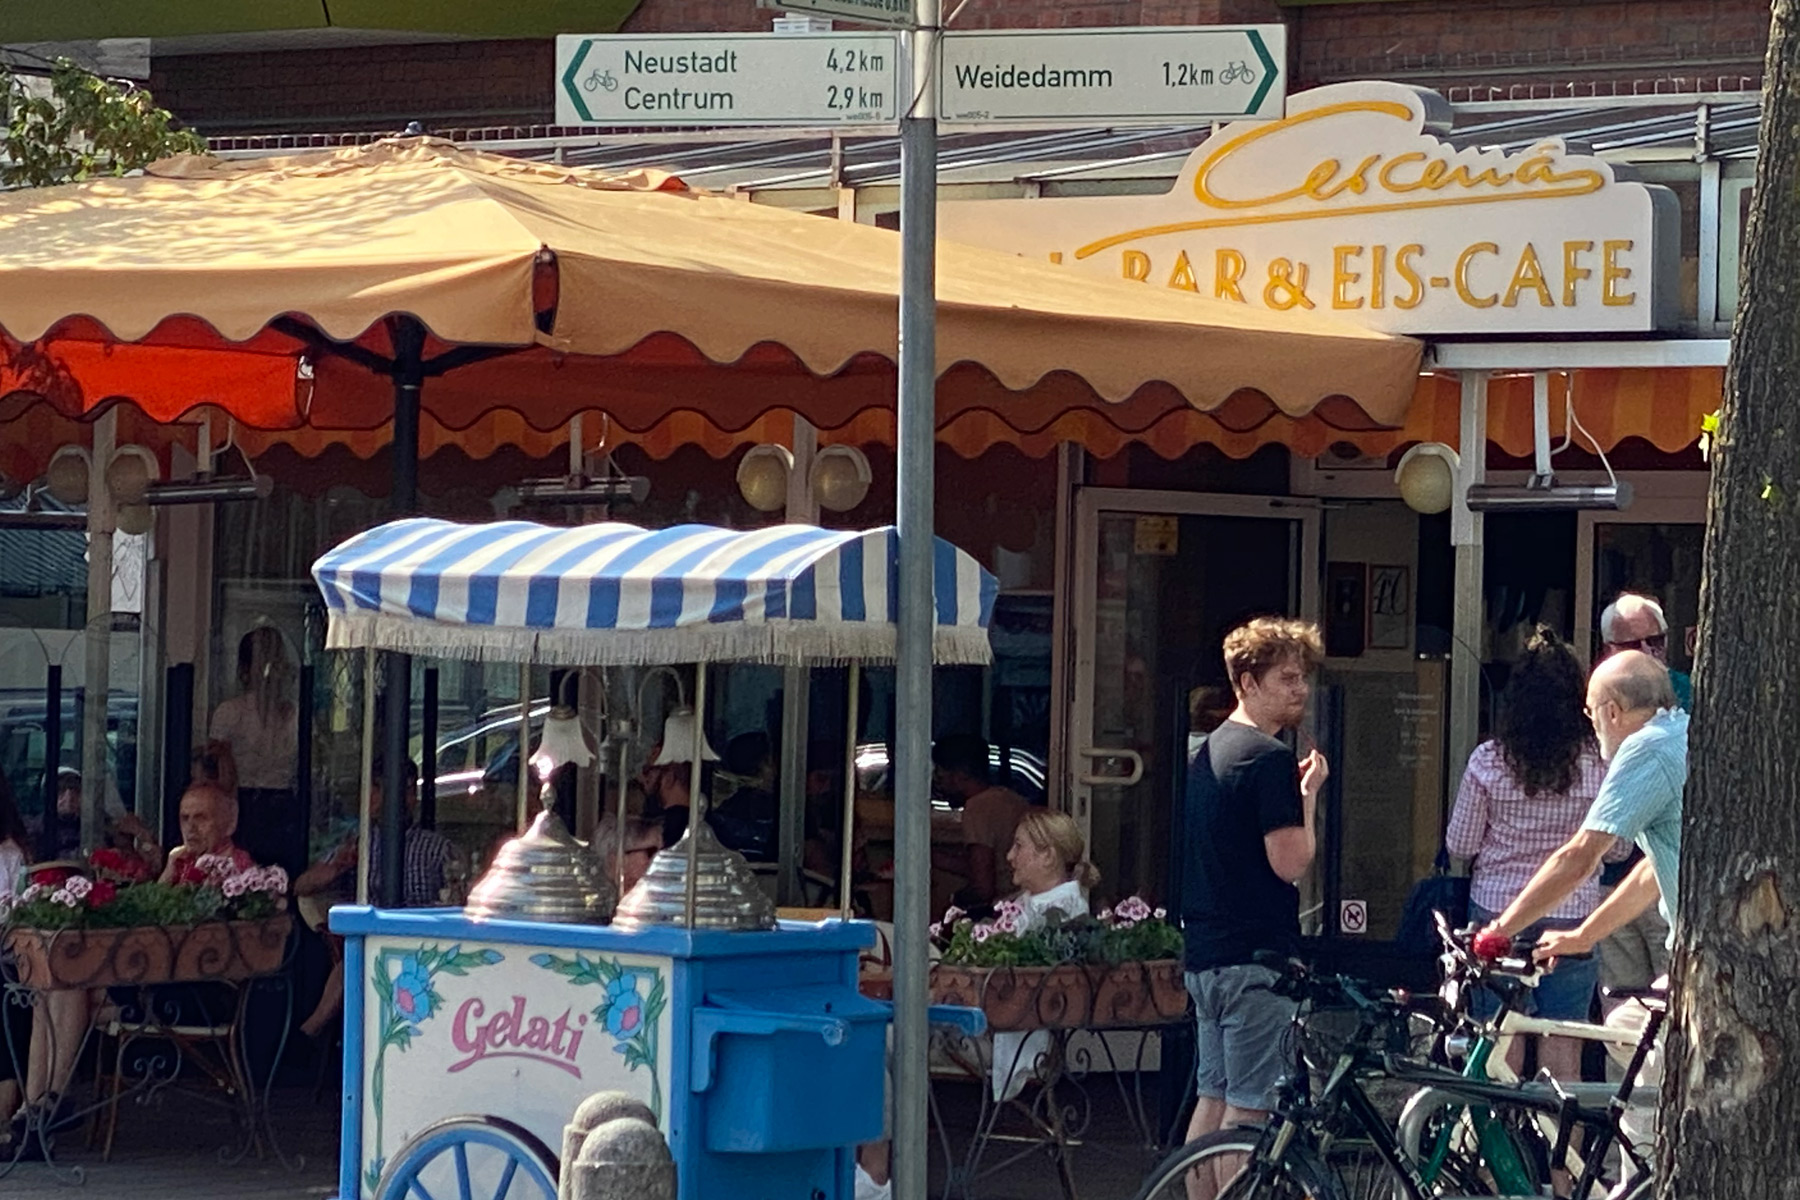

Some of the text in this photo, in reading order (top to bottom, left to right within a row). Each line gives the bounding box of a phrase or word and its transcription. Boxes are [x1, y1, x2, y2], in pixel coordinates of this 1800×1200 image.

[624, 50, 738, 74] Neustadt
[955, 64, 1113, 90] Weidedamm
[624, 86, 734, 111] Centrum
[1332, 240, 1636, 310] EIS-CAFE
[450, 995, 589, 1064] Gelati
